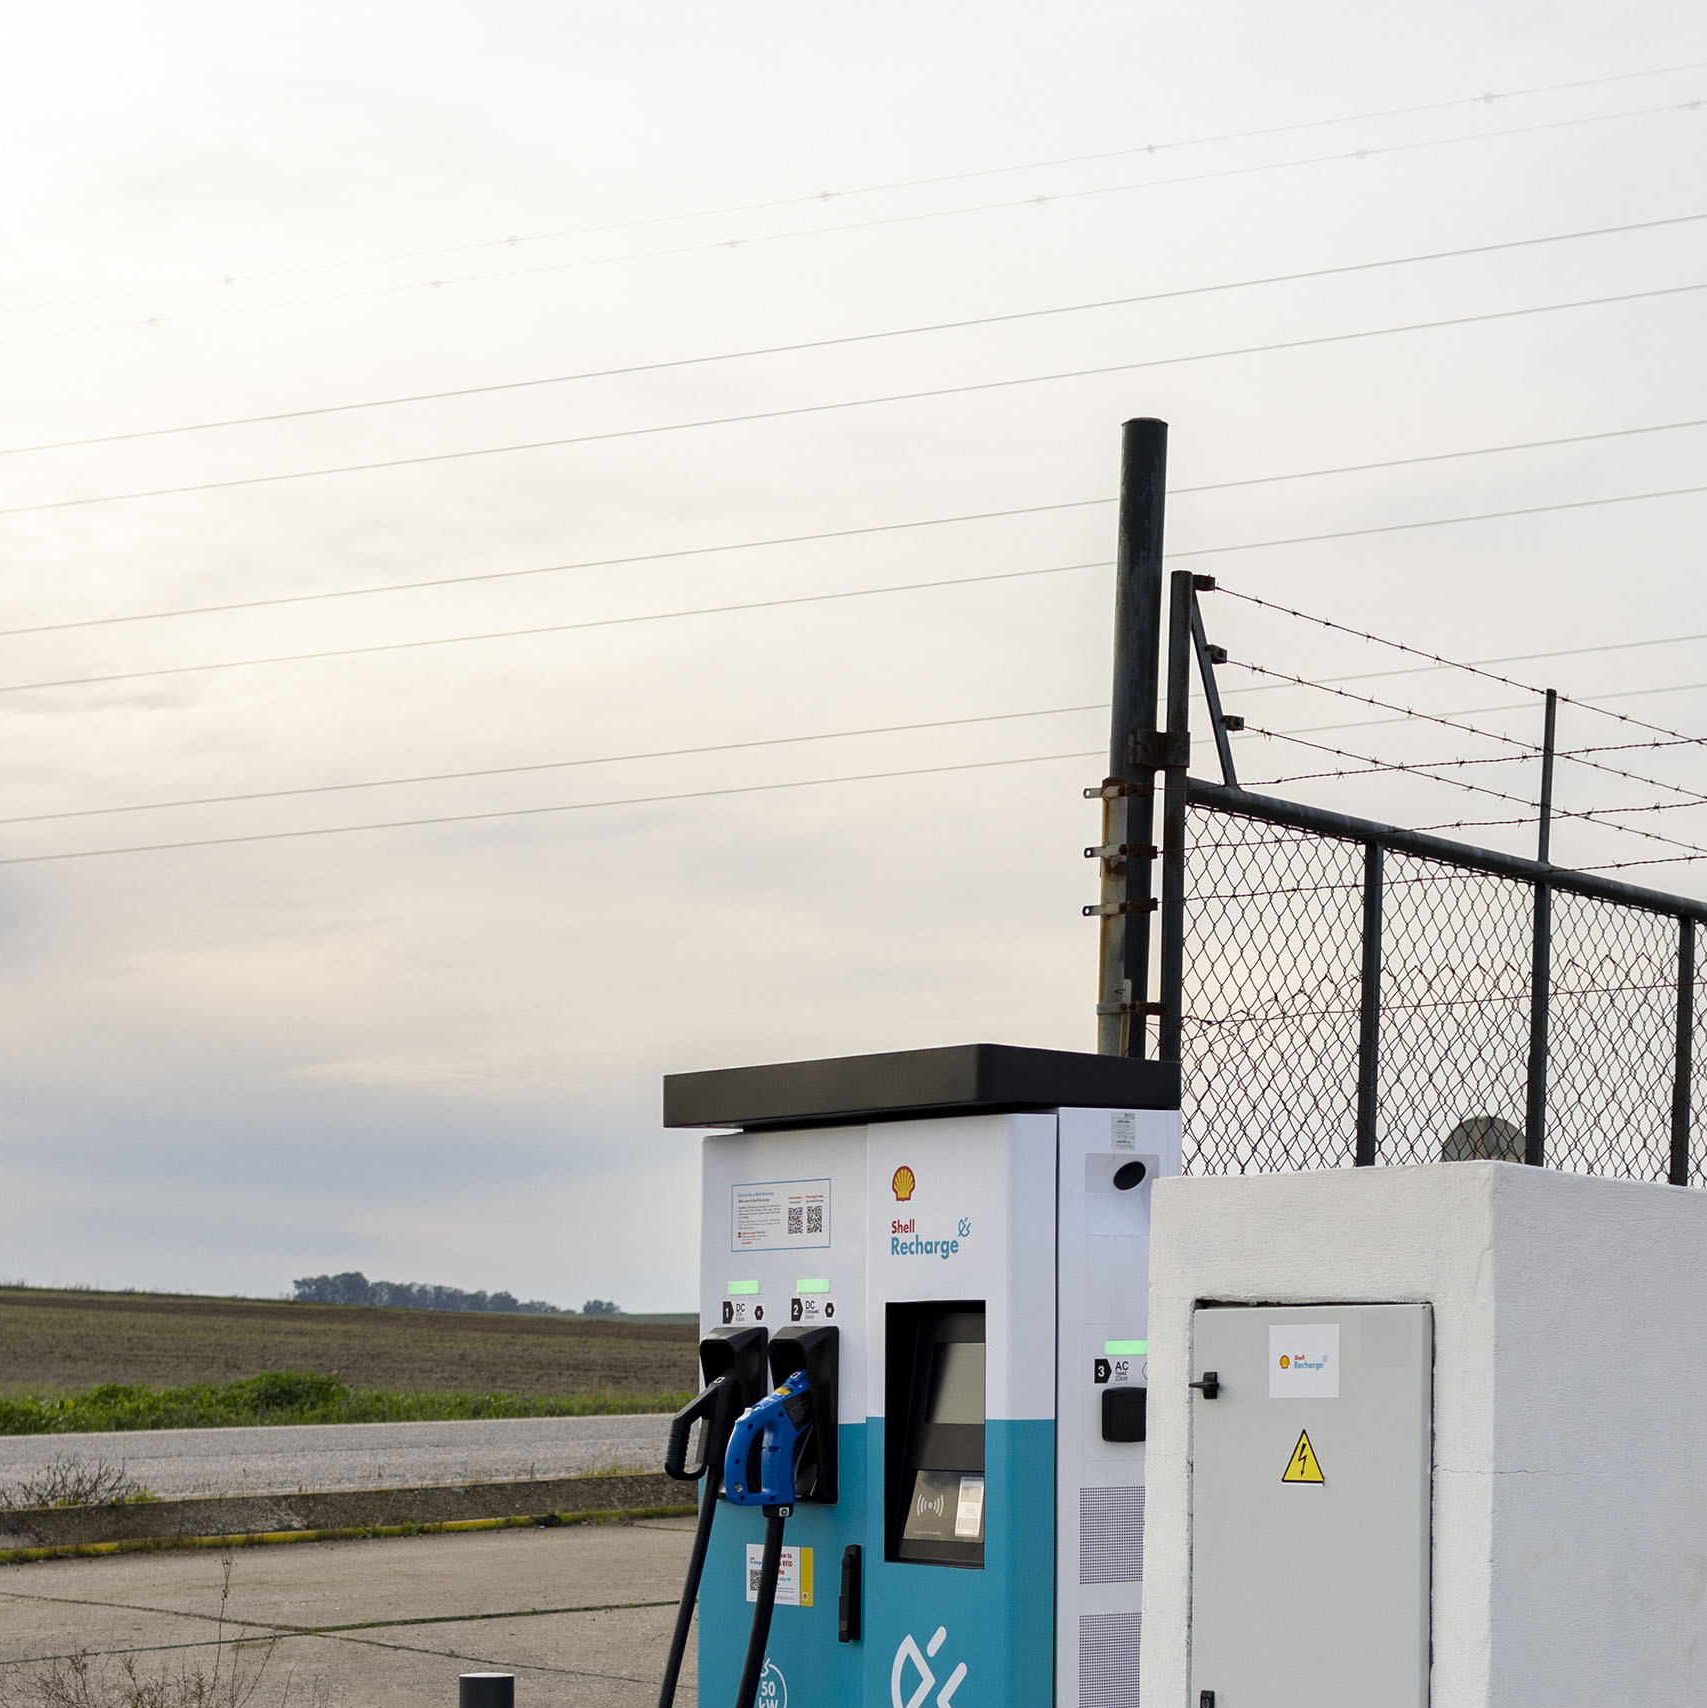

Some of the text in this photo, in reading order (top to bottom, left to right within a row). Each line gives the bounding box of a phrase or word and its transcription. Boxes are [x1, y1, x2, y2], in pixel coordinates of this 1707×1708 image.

[891, 1218, 915, 1234] Shell
[891, 1234, 959, 1260] Recharge
[736, 1303, 746, 1312] DC
[793, 1304, 799, 1316] 2
[805, 1300, 815, 1310] DC
[724, 1307, 730, 1319] 1
[1098, 1365, 1105, 1378] 3
[1115, 1361, 1129, 1371] AC
[1294, 1360, 1323, 1371] Recharge
[761, 1681, 776, 1697] 50
